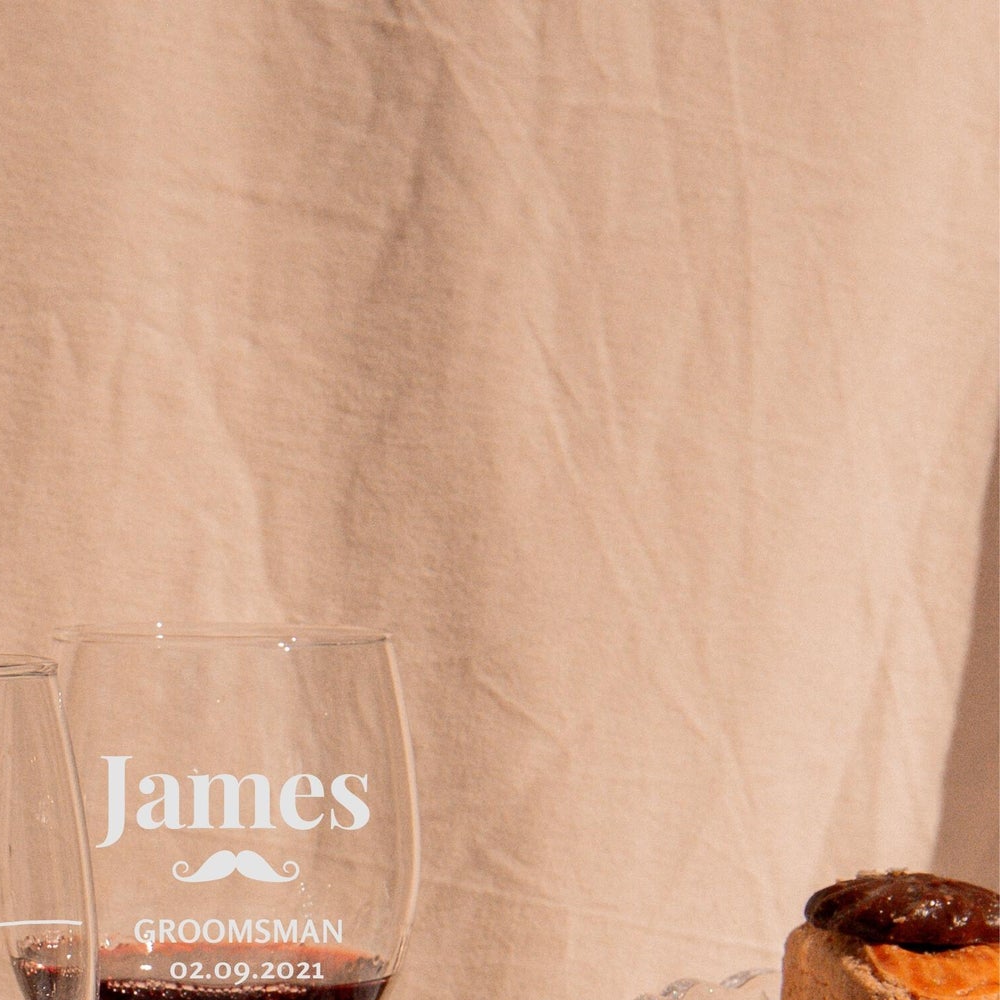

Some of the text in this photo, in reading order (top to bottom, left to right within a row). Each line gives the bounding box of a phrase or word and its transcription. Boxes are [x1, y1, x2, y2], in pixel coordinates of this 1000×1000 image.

[95, 755, 371, 848] James
[133, 918, 343, 945] GROOMSMAN
[169, 961, 324, 986] 02.09.2021
